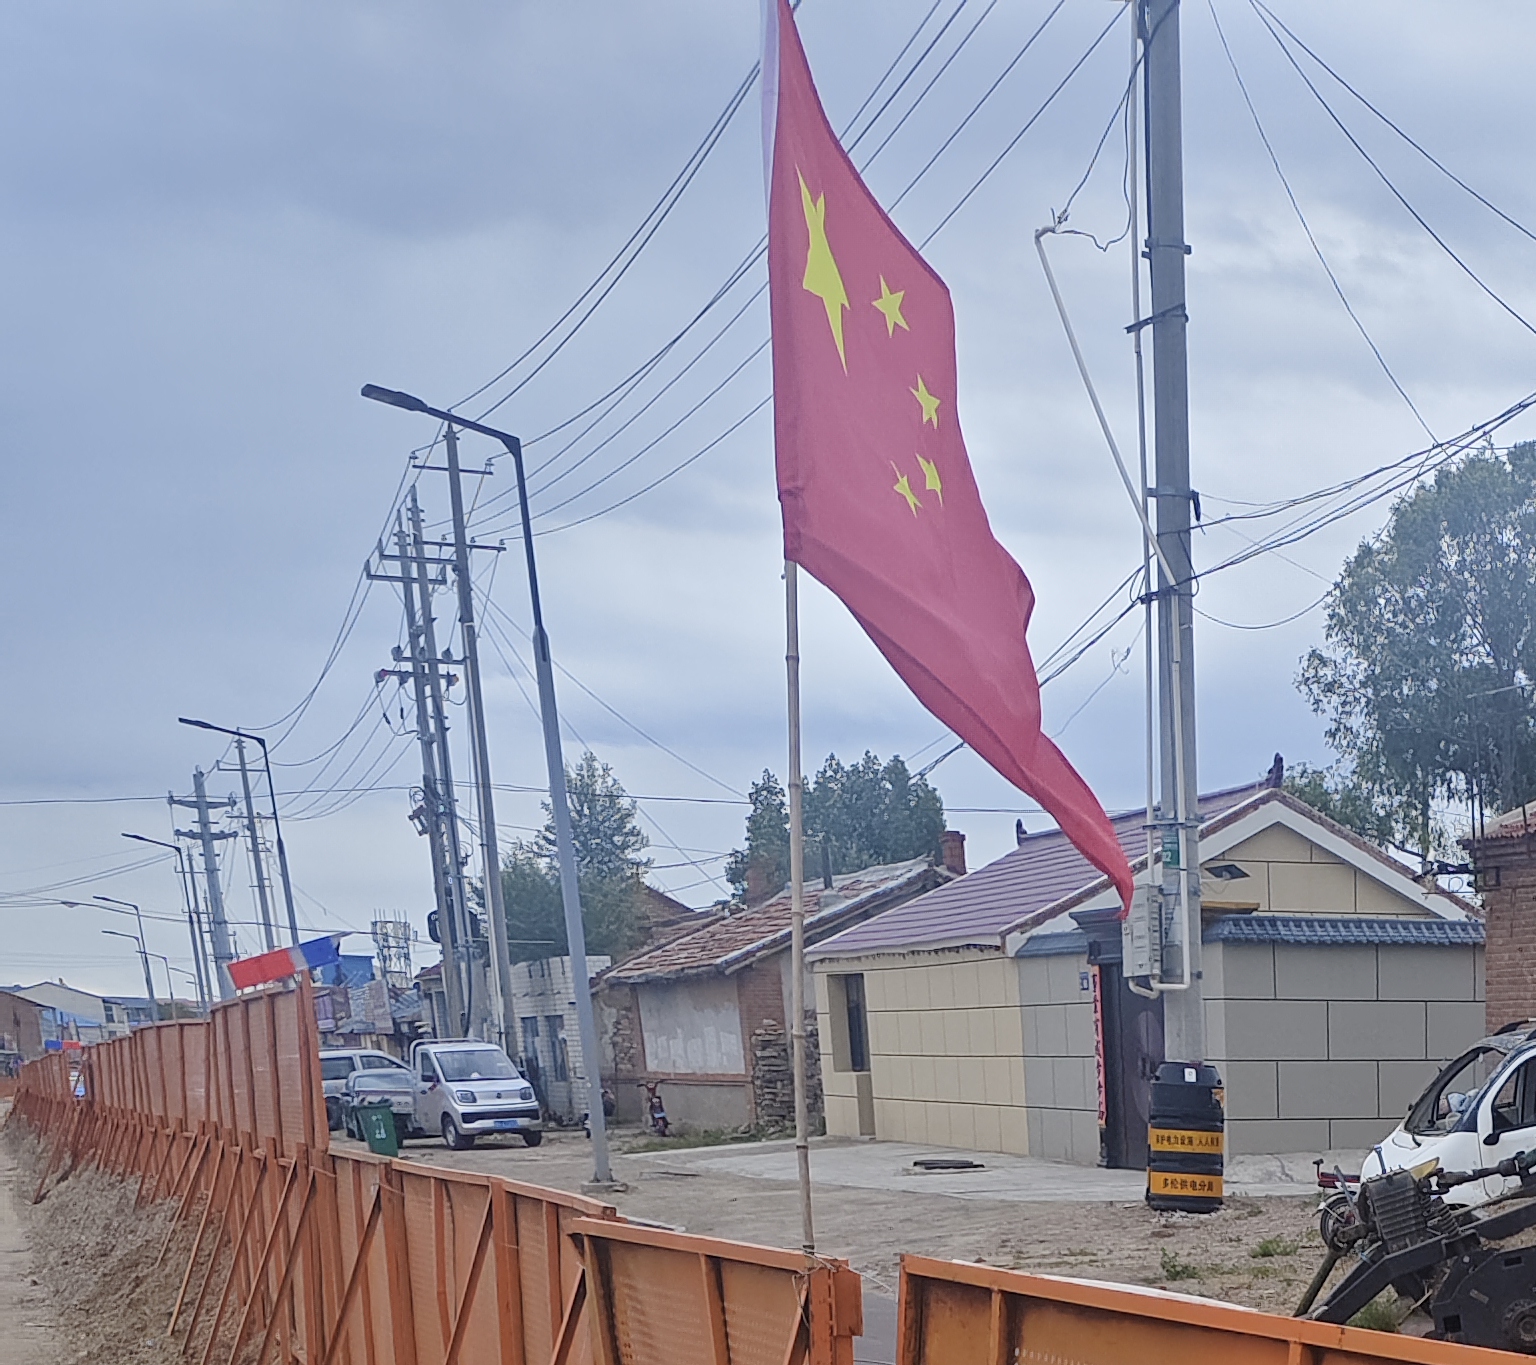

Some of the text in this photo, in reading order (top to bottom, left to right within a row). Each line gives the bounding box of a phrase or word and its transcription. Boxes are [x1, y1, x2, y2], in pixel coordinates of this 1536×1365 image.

[1163, 1177, 1214, 1192] 多伦供电分局
